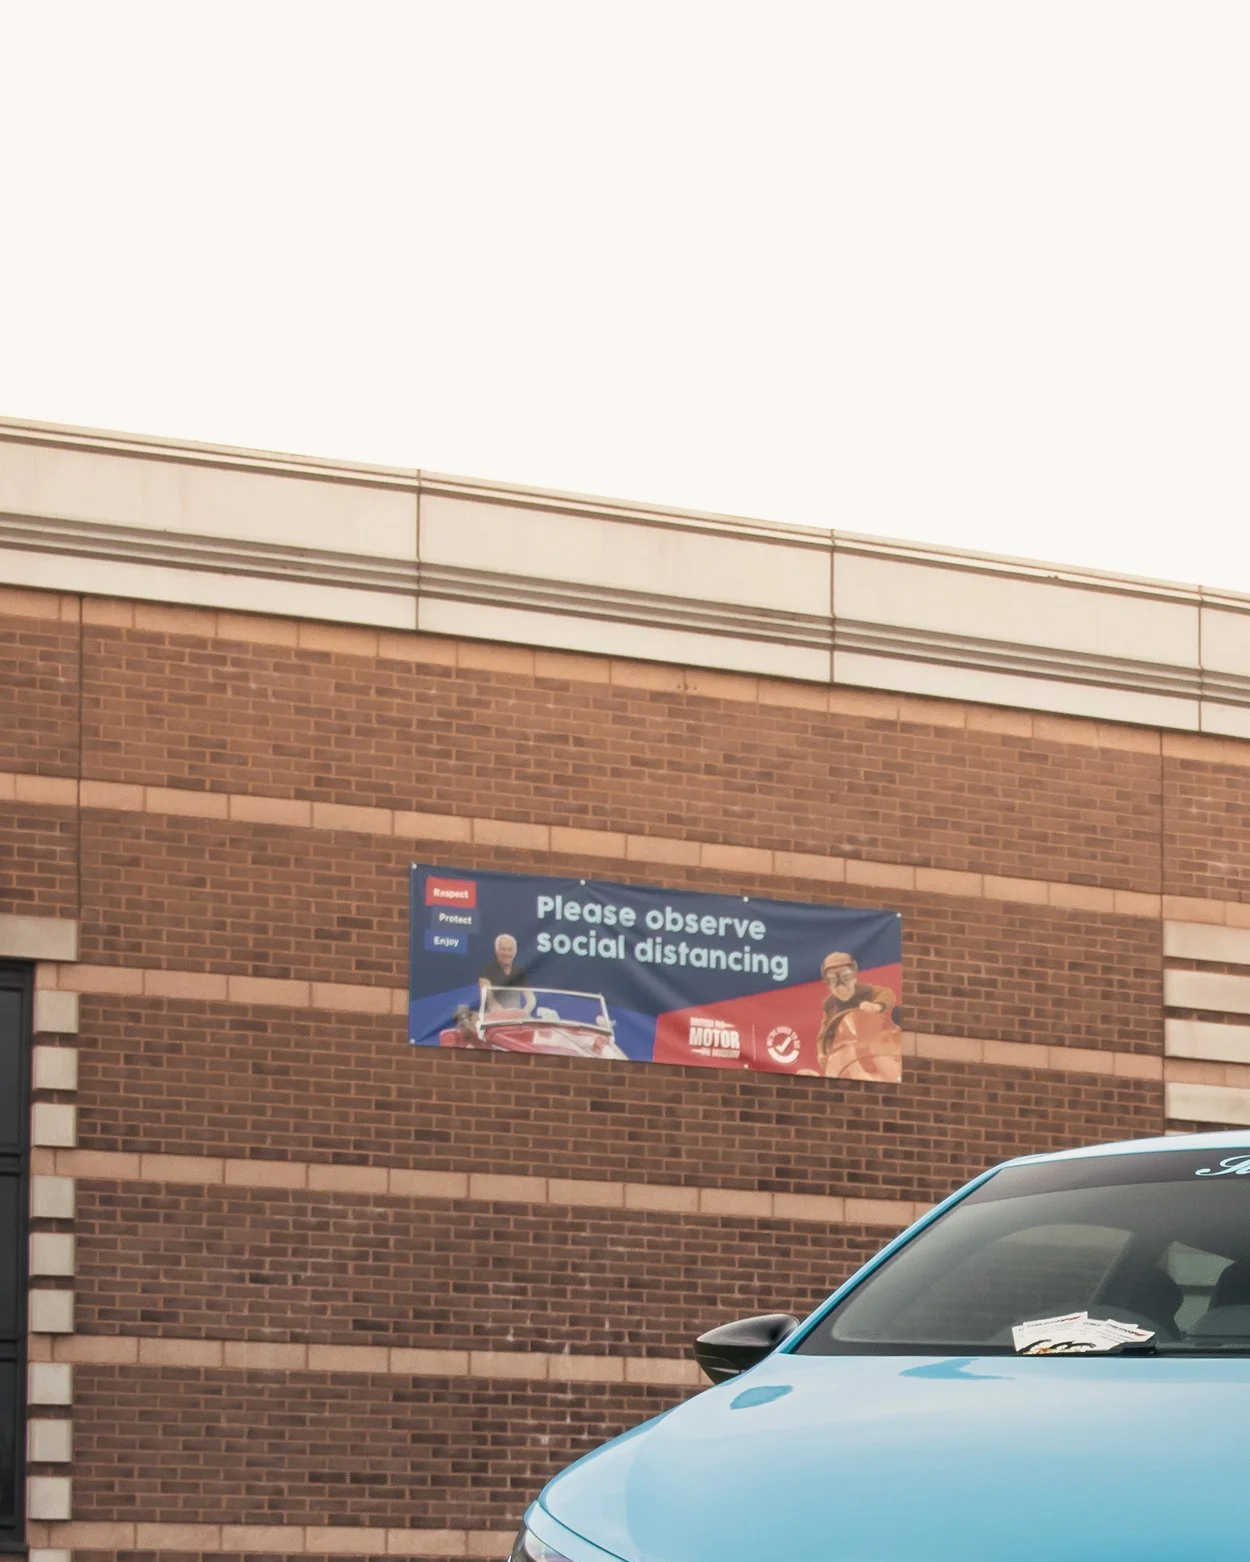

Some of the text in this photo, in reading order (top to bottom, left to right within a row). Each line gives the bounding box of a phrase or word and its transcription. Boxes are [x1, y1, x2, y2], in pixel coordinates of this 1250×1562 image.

[432, 887, 469, 900] Respect
[439, 912, 472, 925] Protect
[537, 895, 766, 940] Please observe
[433, 935, 460, 947] Enjoy
[537, 930, 789, 982] social distancing
[688, 1027, 740, 1050] MOTOR
